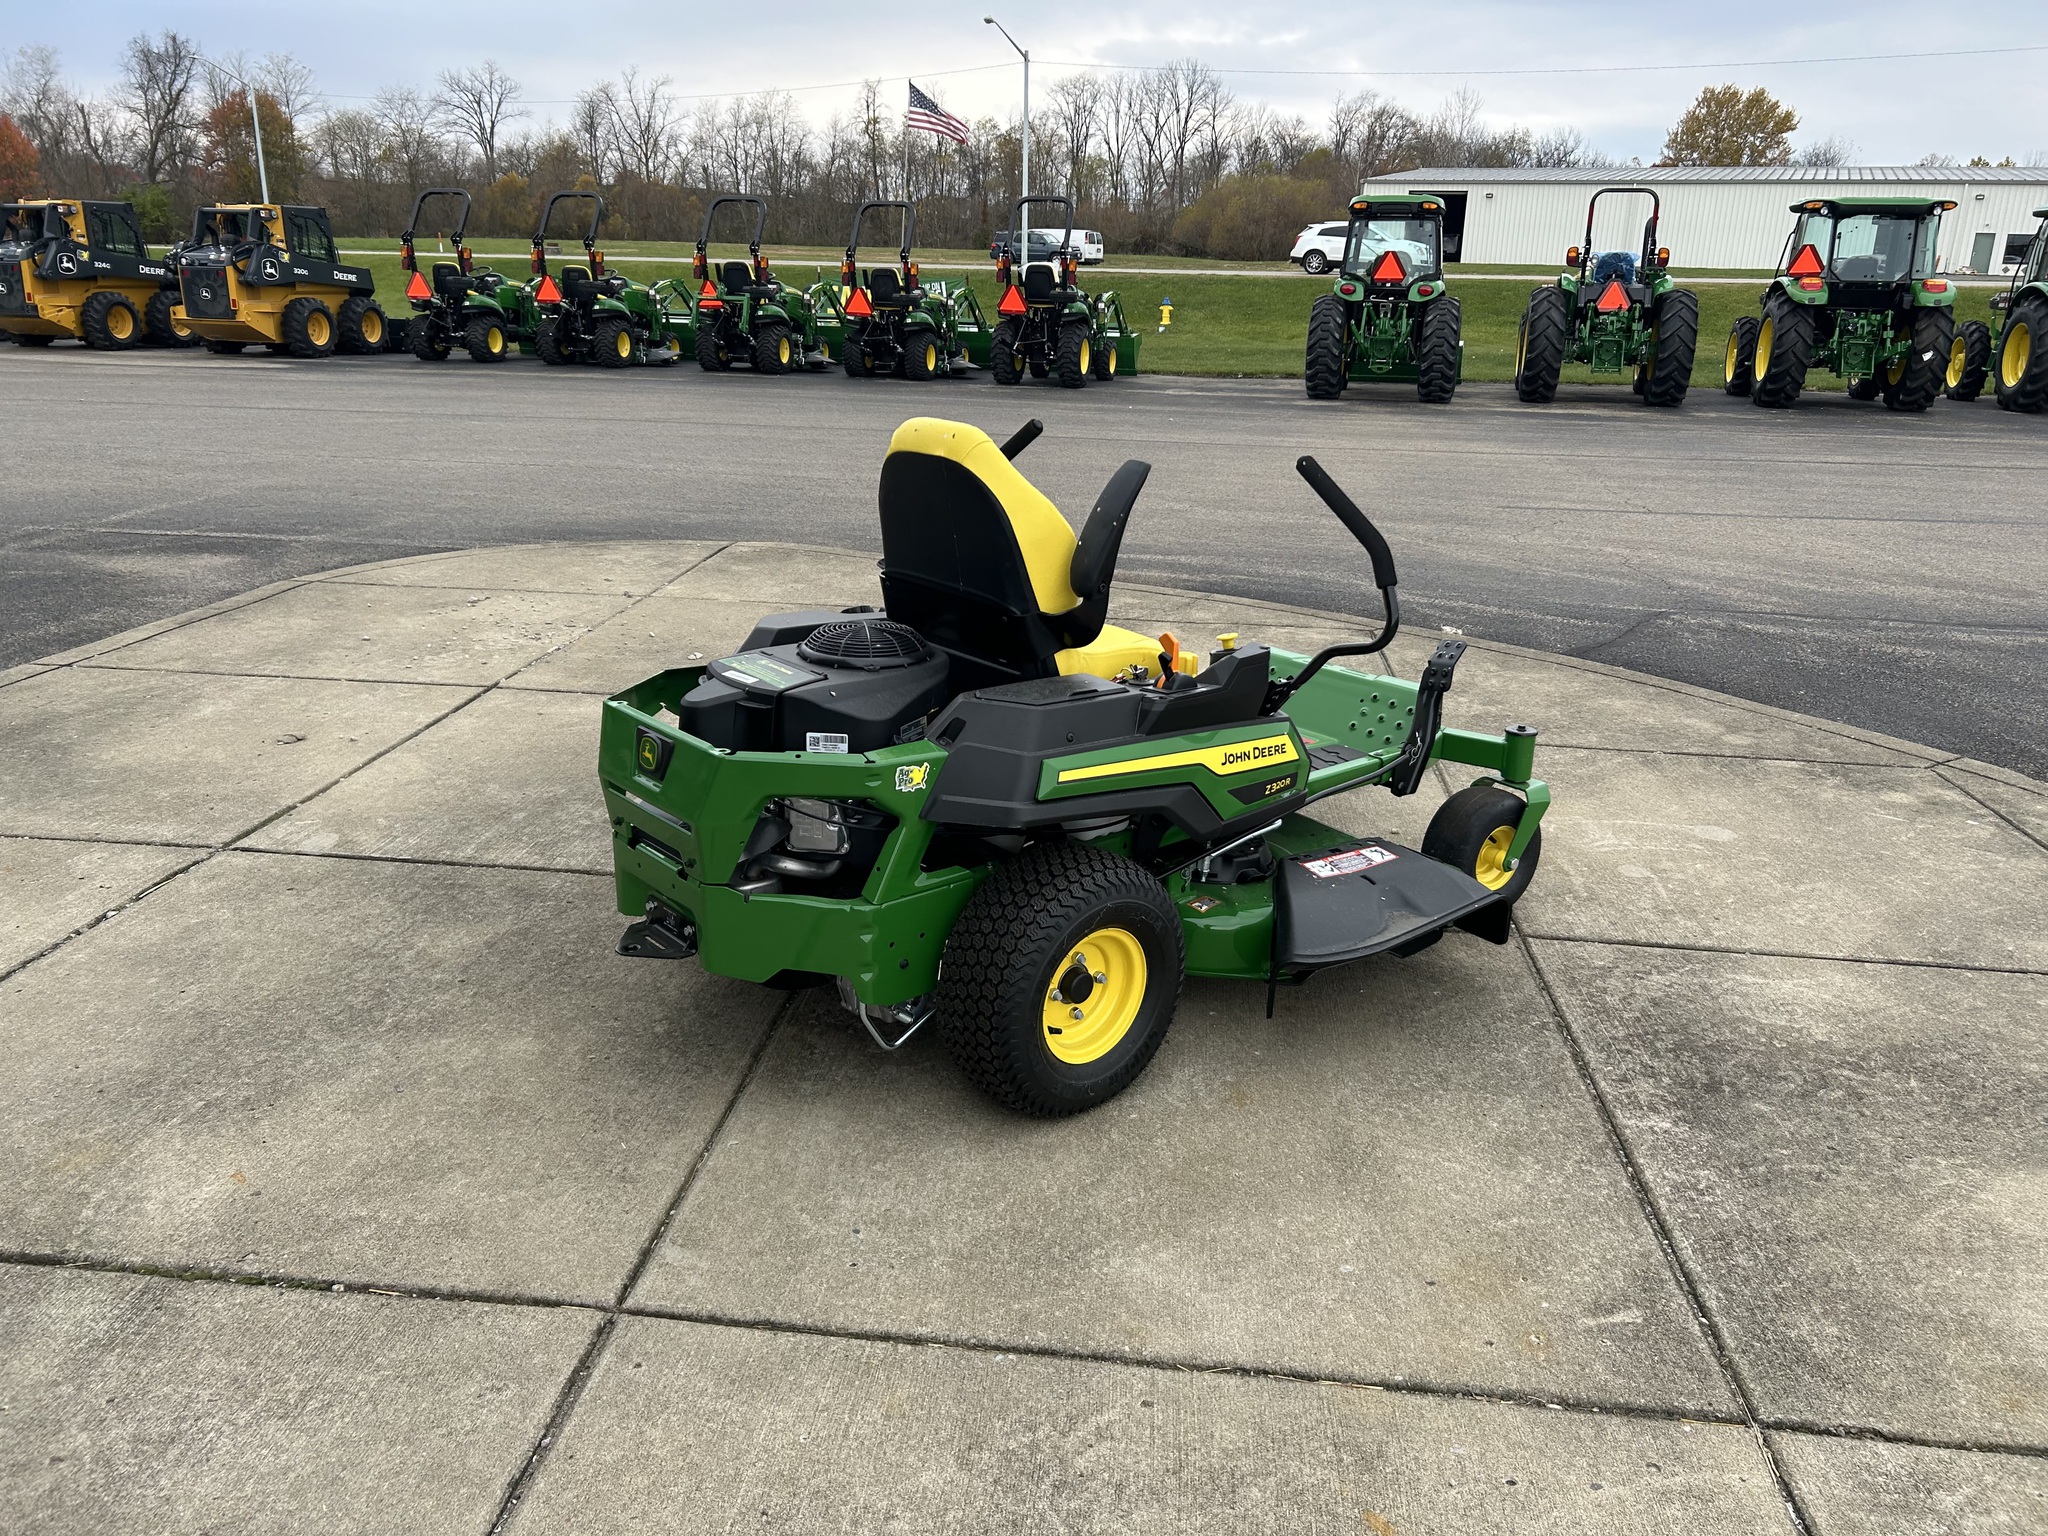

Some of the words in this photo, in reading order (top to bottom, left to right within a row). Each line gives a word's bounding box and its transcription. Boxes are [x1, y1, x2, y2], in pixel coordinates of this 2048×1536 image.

[93, 261, 111, 269] 324G
[139, 265, 166, 275] DEERE
[293, 267, 309, 276] 320G
[333, 271, 358, 281] DEERE
[1221, 750, 1251, 766] JOHN
[1253, 743, 1287, 760] DEERE
[898, 777, 914, 787] Pro
[1264, 777, 1291, 795] Z320R
